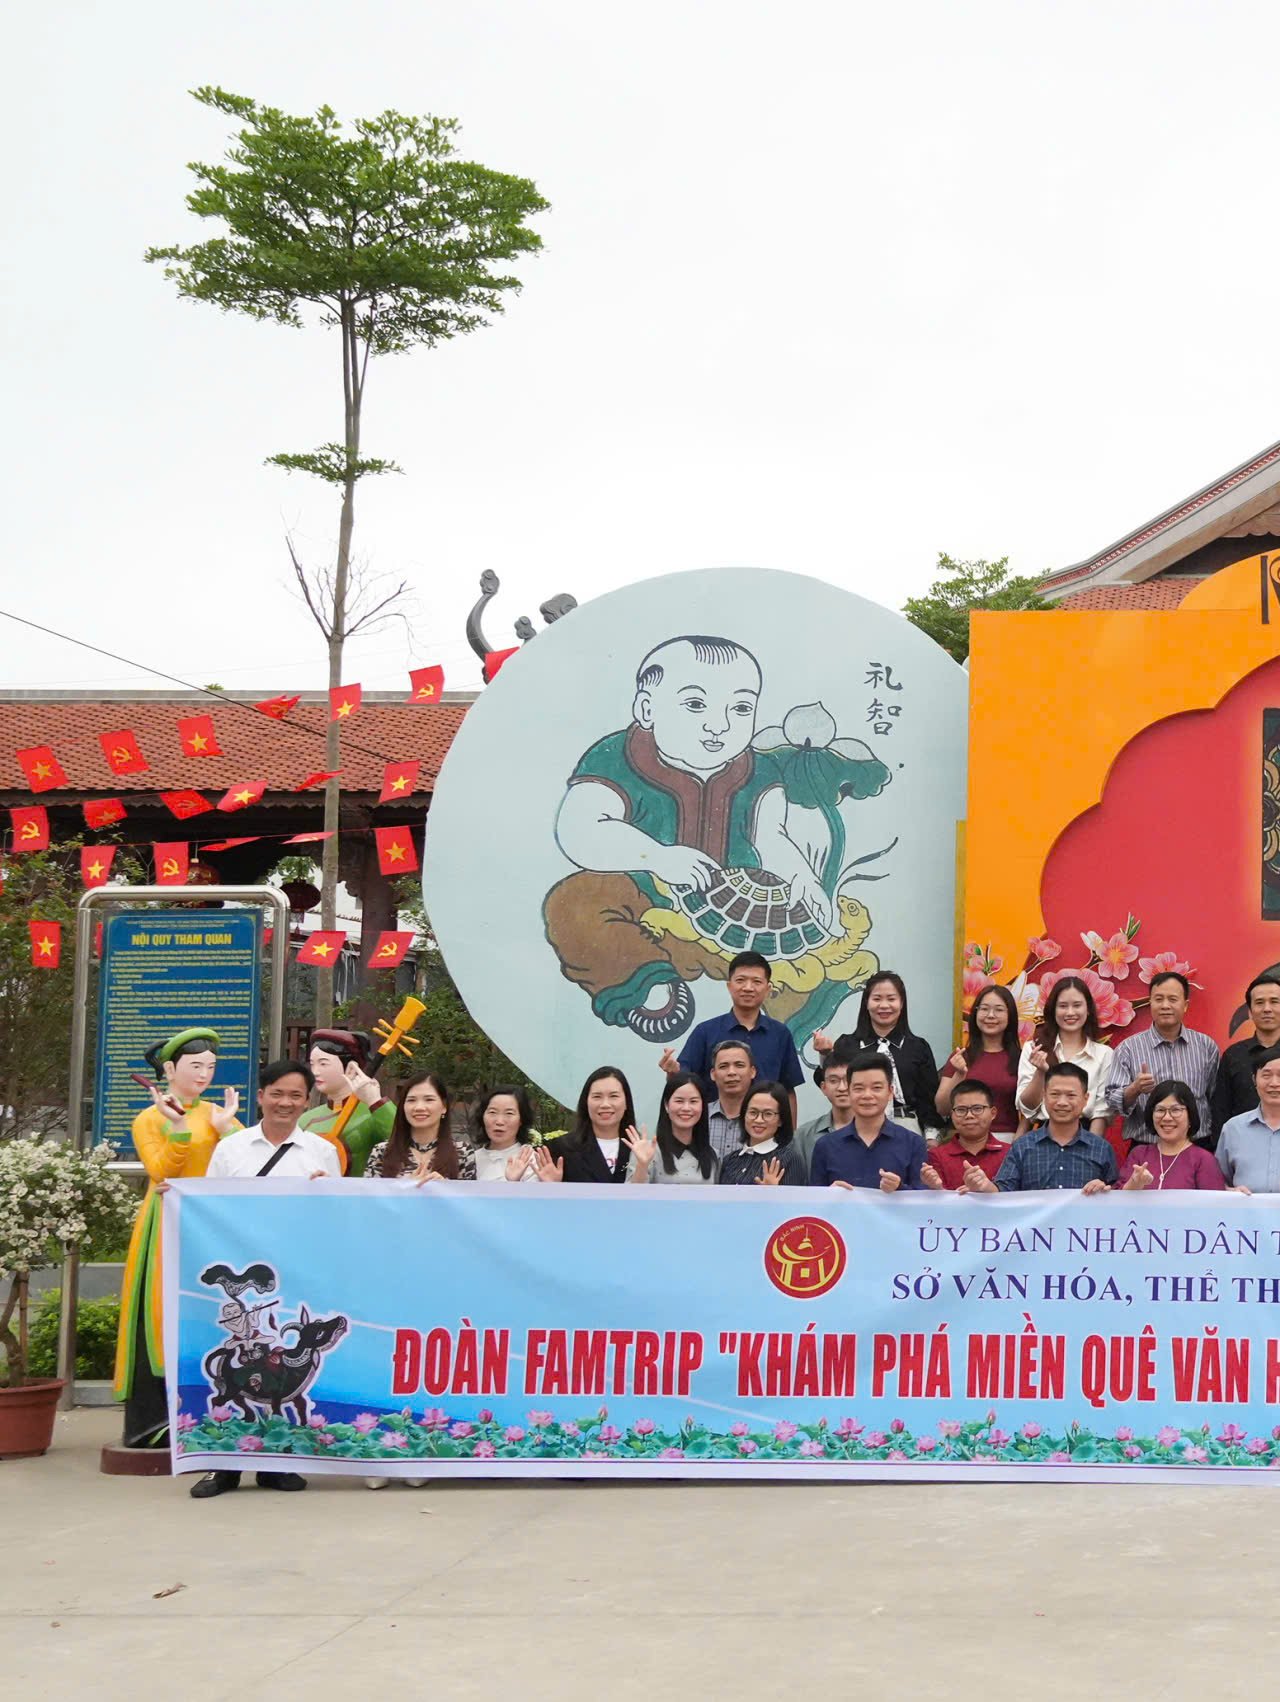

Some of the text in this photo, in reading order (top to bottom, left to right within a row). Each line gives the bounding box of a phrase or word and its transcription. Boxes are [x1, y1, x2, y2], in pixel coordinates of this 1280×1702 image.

[131, 931, 232, 947] NỘI QUY THAM QUAN
[918, 1218, 968, 1254] ỦY
[979, 1225, 1055, 1254] BAN
[1066, 1220, 1171, 1256] NHÂN
[1183, 1221, 1260, 1258] DÂN
[892, 1266, 942, 1302] SỞ
[952, 1267, 1029, 1302] VĂN
[1041, 1266, 1133, 1306] HÓA,
[1144, 1268, 1220, 1304] THỂ
[392, 1317, 511, 1396] ĐOÀN
[523, 1328, 704, 1397] FAMTRIP
[718, 1322, 857, 1398] "KHÁM
[872, 1323, 957, 1399] PHÁ
[966, 1312, 1066, 1401] MIỀN
[1080, 1324, 1157, 1409] QUÊ
[1170, 1326, 1251, 1404] VĂN
